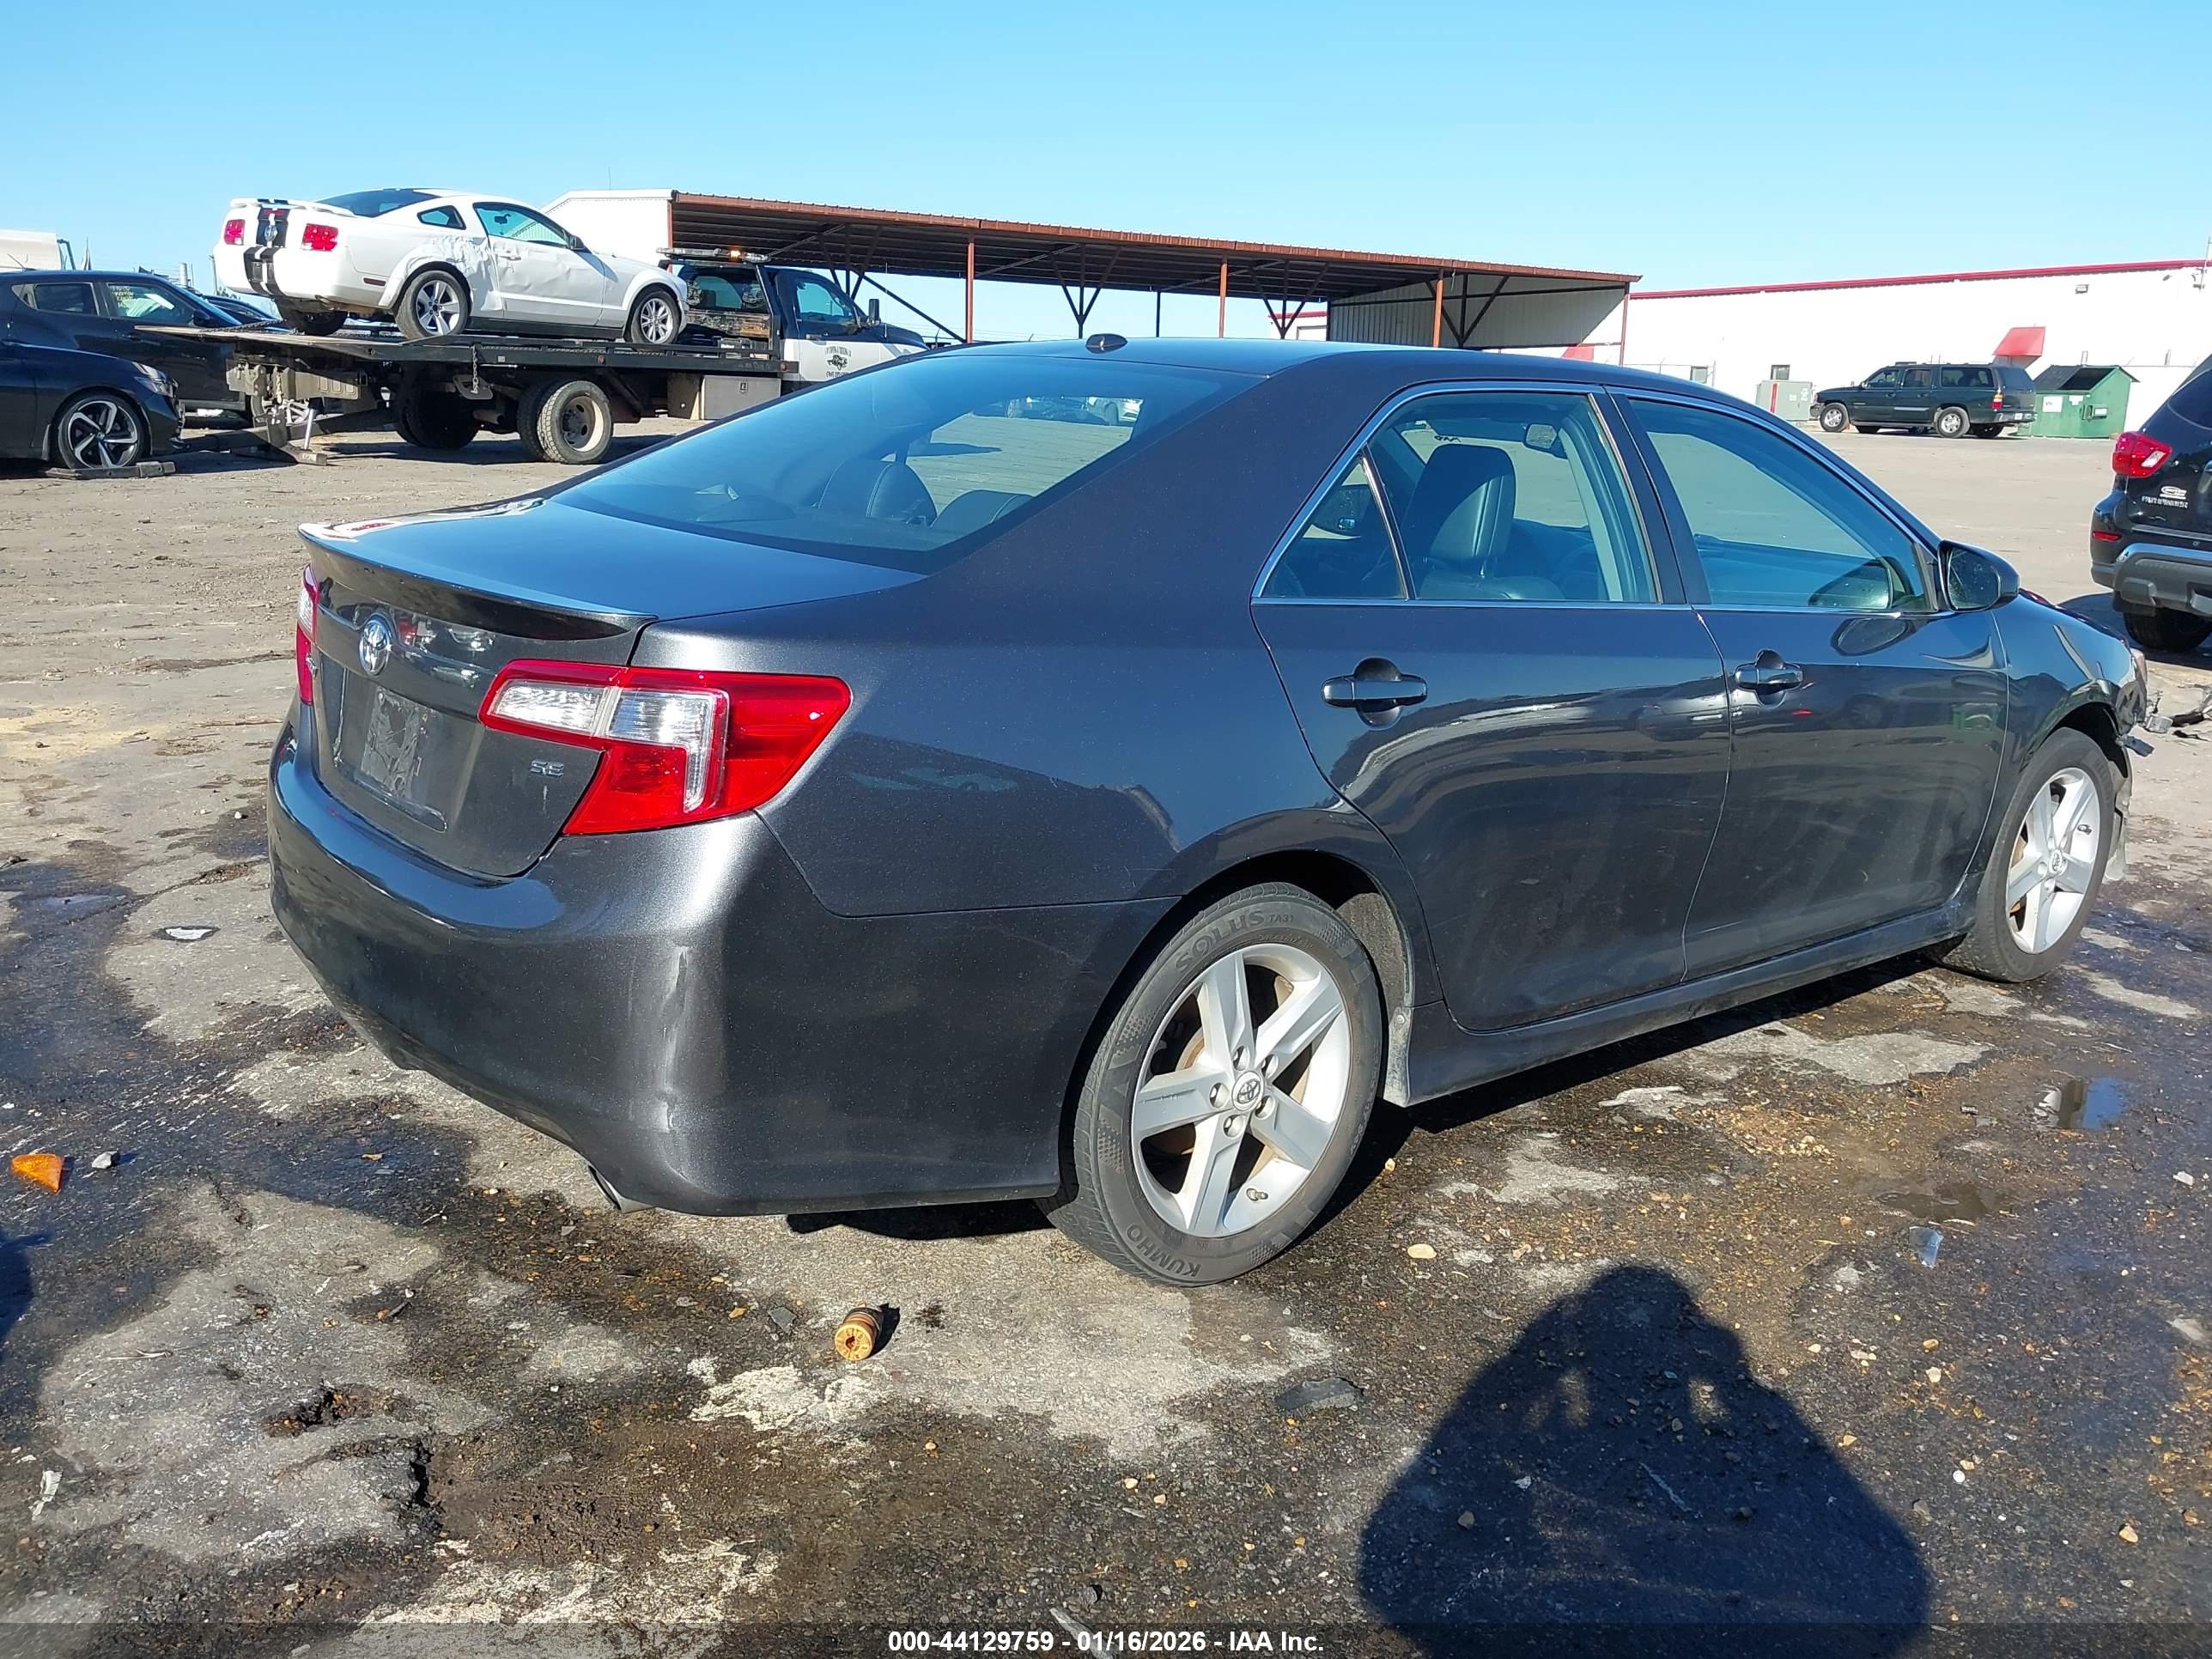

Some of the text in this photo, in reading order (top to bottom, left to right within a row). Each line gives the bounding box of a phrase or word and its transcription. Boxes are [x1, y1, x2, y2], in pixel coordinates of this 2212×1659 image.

[530, 760, 564, 777] SE
[1174, 909, 1266, 973] SOLUS
[1126, 1223, 1202, 1278] KUMHO
